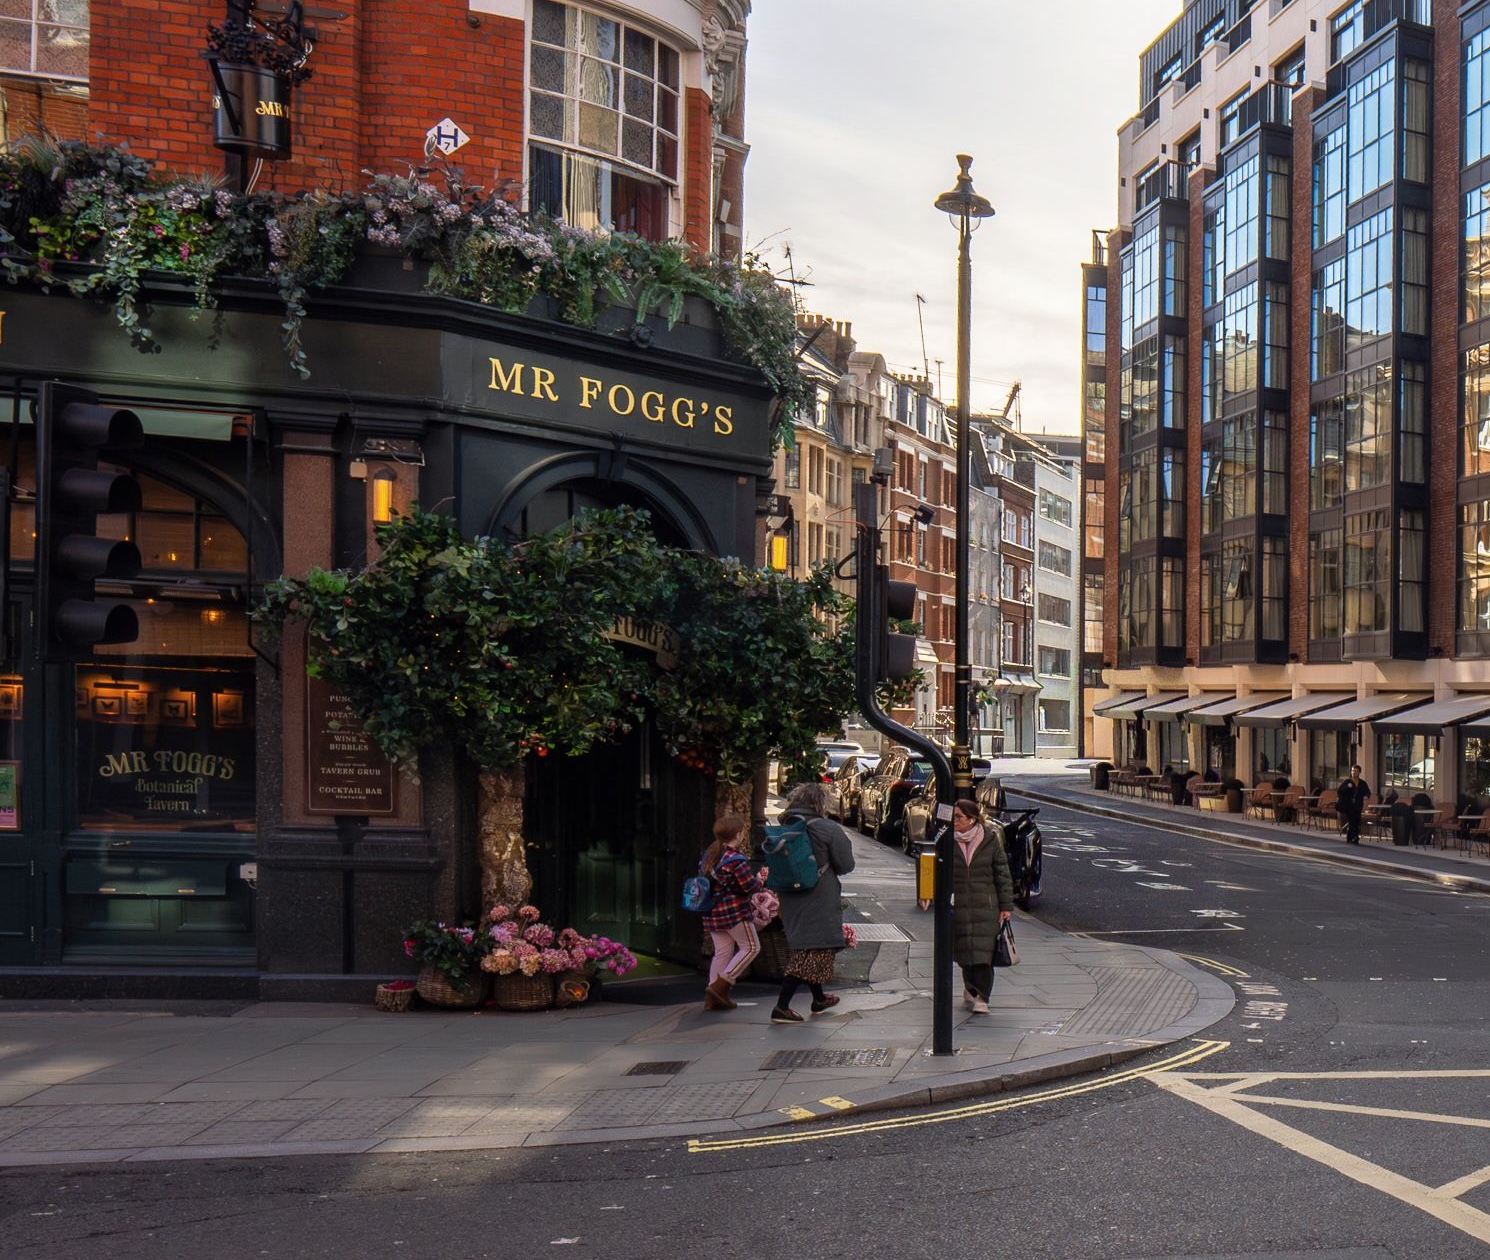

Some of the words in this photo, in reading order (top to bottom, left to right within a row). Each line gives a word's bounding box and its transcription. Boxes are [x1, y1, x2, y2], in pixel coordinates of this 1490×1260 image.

[255, 100, 283, 117] MR
[437, 126, 458, 148] H
[444, 141, 451, 151] 7
[488, 357, 560, 402] MR
[579, 376, 734, 436] FOGG'S
[329, 743, 369, 751] BUBBLES
[334, 735, 357, 743] WINE
[99, 750, 150, 777] MR
[153, 750, 237, 780] FOGG'S
[320, 767, 354, 775] TAVERN
[357, 768, 381, 776] GRUB
[135, 777, 204, 795] Botanical
[319, 786, 363, 795] COCKTAIL
[365, 787, 383, 795] BAR
[144, 795, 190, 812] Tavern
